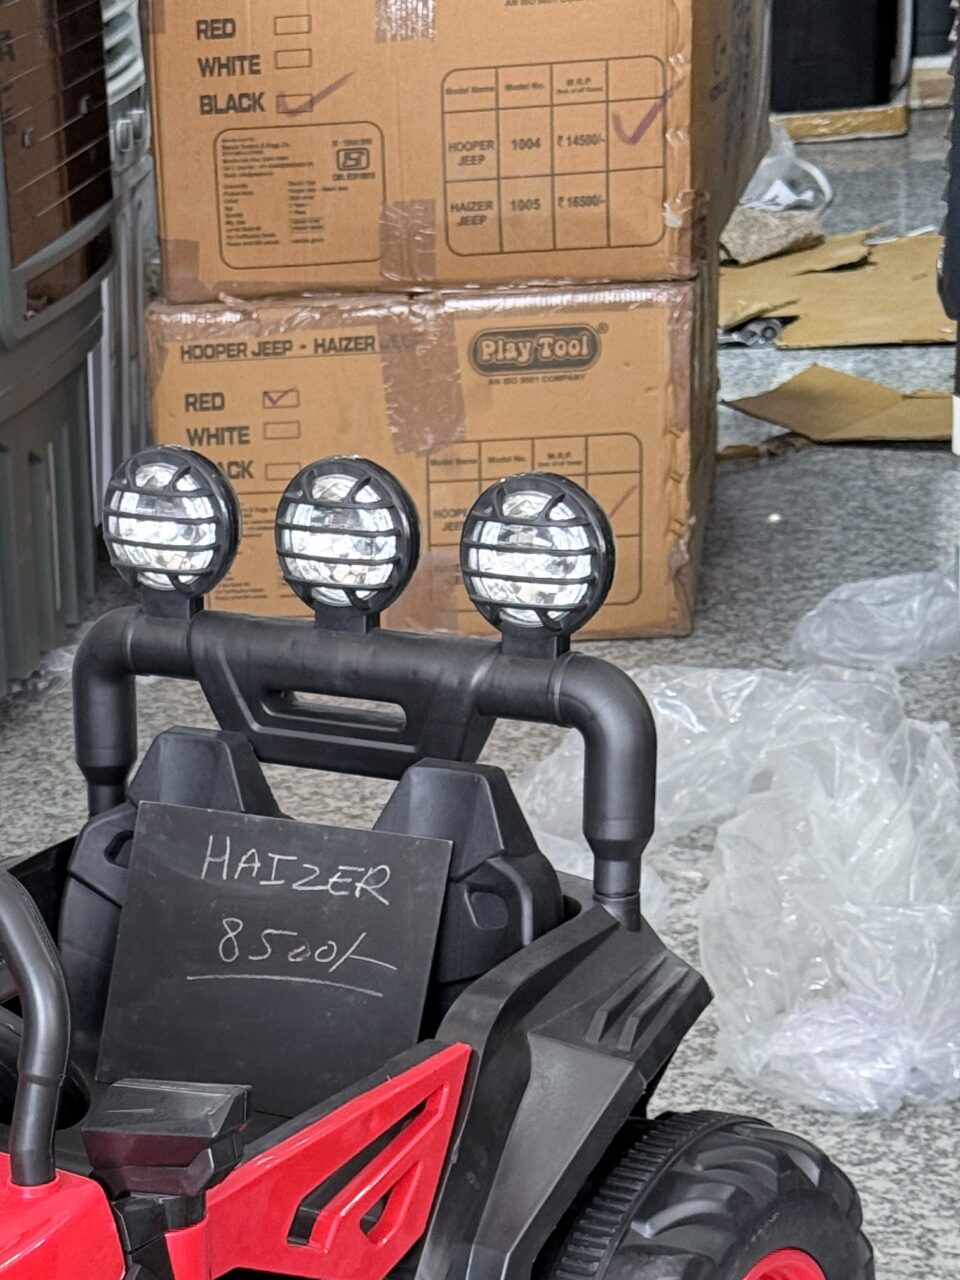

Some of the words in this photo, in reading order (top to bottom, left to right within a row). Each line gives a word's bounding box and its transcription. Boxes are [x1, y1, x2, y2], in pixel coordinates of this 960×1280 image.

[196, 18, 236, 40] RED
[197, 54, 261, 77] WHITE
[199, 91, 265, 115] BLACK
[449, 140, 495, 152] HOOPER
[511, 137, 541, 150] 1004
[458, 155, 486, 166] JEEP
[450, 201, 494, 213] HAIZER
[510, 198, 541, 211] 1005
[458, 215, 487, 226] JEEP
[180, 342, 247, 361] HOOPER
[252, 339, 293, 357] JEEP
[314, 335, 376, 354] HAIZER
[481, 338, 532, 363] Play
[539, 334, 589, 358] Tool
[185, 392, 225, 412] RED
[186, 426, 251, 447] WHITE
[201, 835, 390, 905] HAIZER
